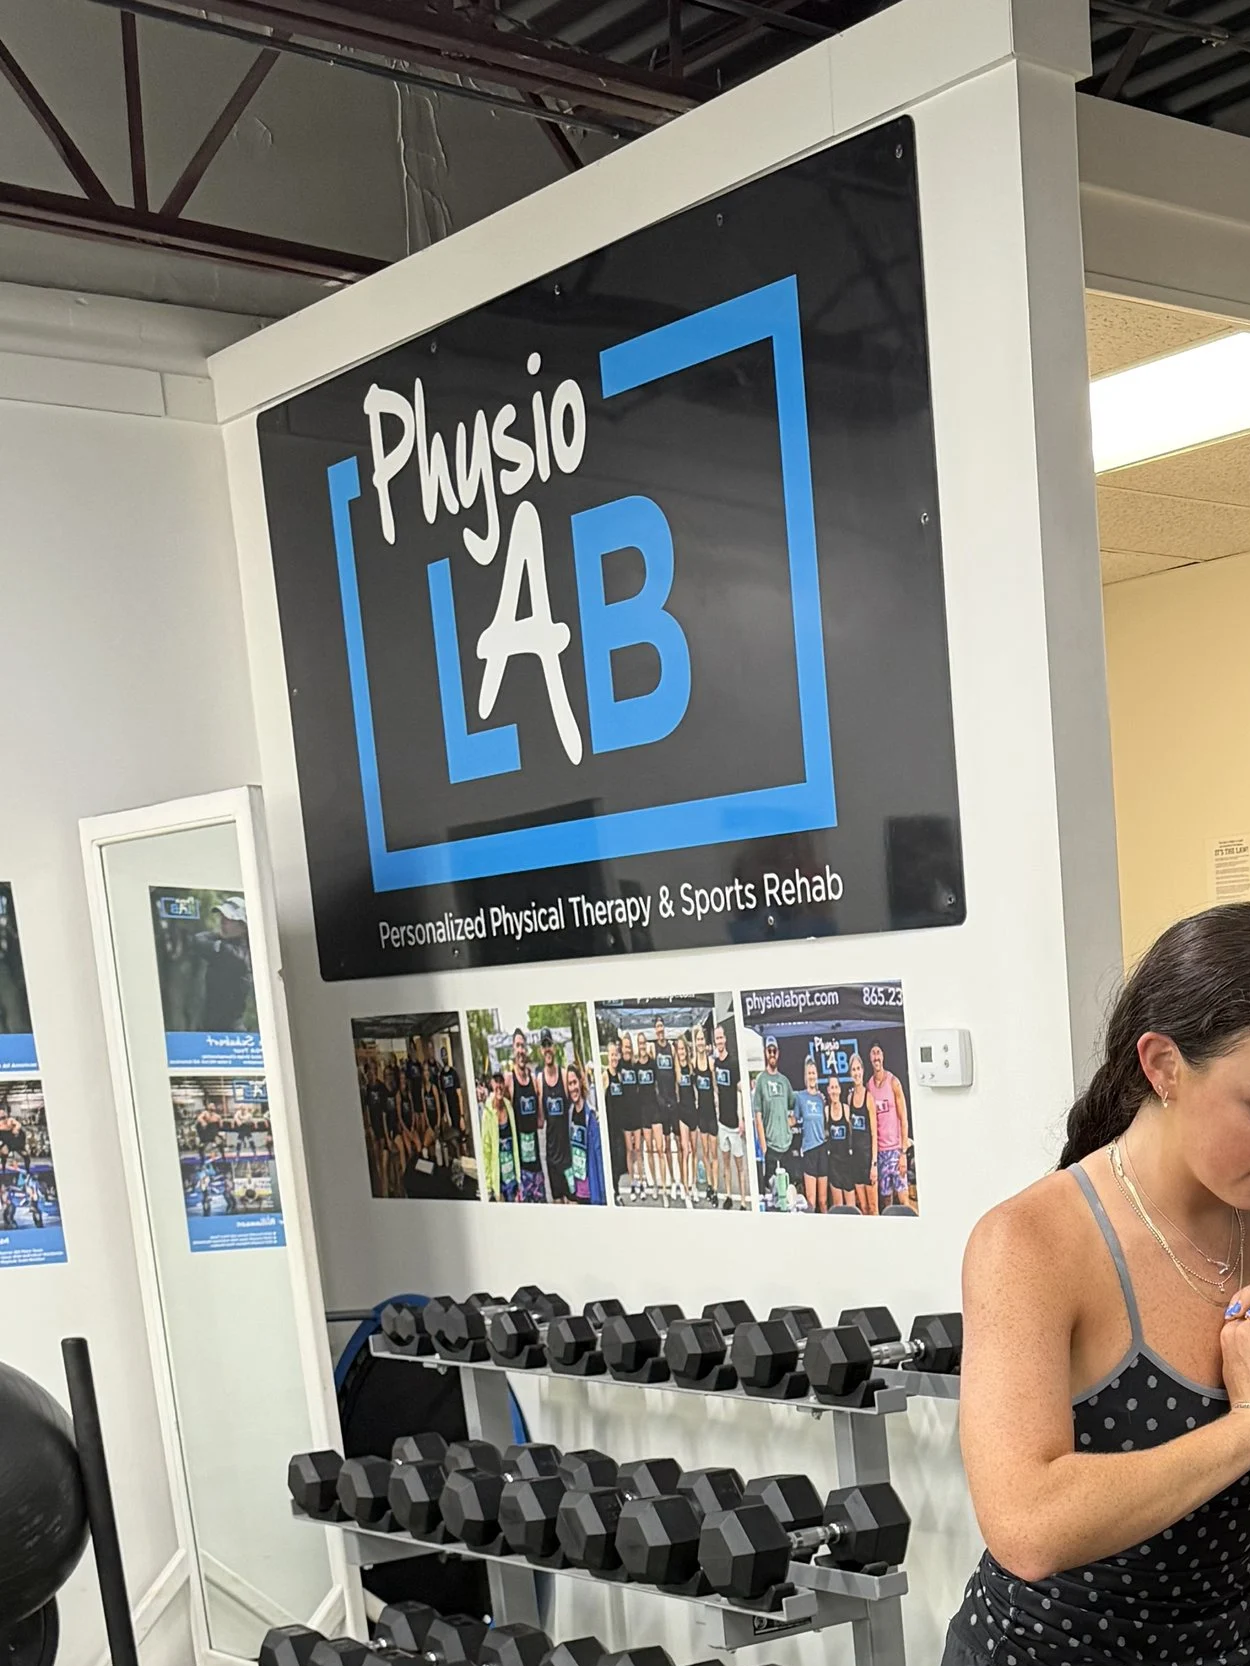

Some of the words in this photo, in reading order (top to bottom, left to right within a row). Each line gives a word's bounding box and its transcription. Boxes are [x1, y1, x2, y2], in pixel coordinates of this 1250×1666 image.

[363, 352, 587, 566] Physio
[427, 495, 692, 784] LAB
[379, 908, 486, 949] Personalized
[490, 897, 565, 941] Physical
[568, 895, 651, 928] Therapy
[659, 885, 675, 919] &
[680, 878, 757, 921] Sports
[763, 865, 843, 907] Rehab
[746, 990, 839, 1015] physiolabpt.com
[821, 1051, 849, 1074] LAB
